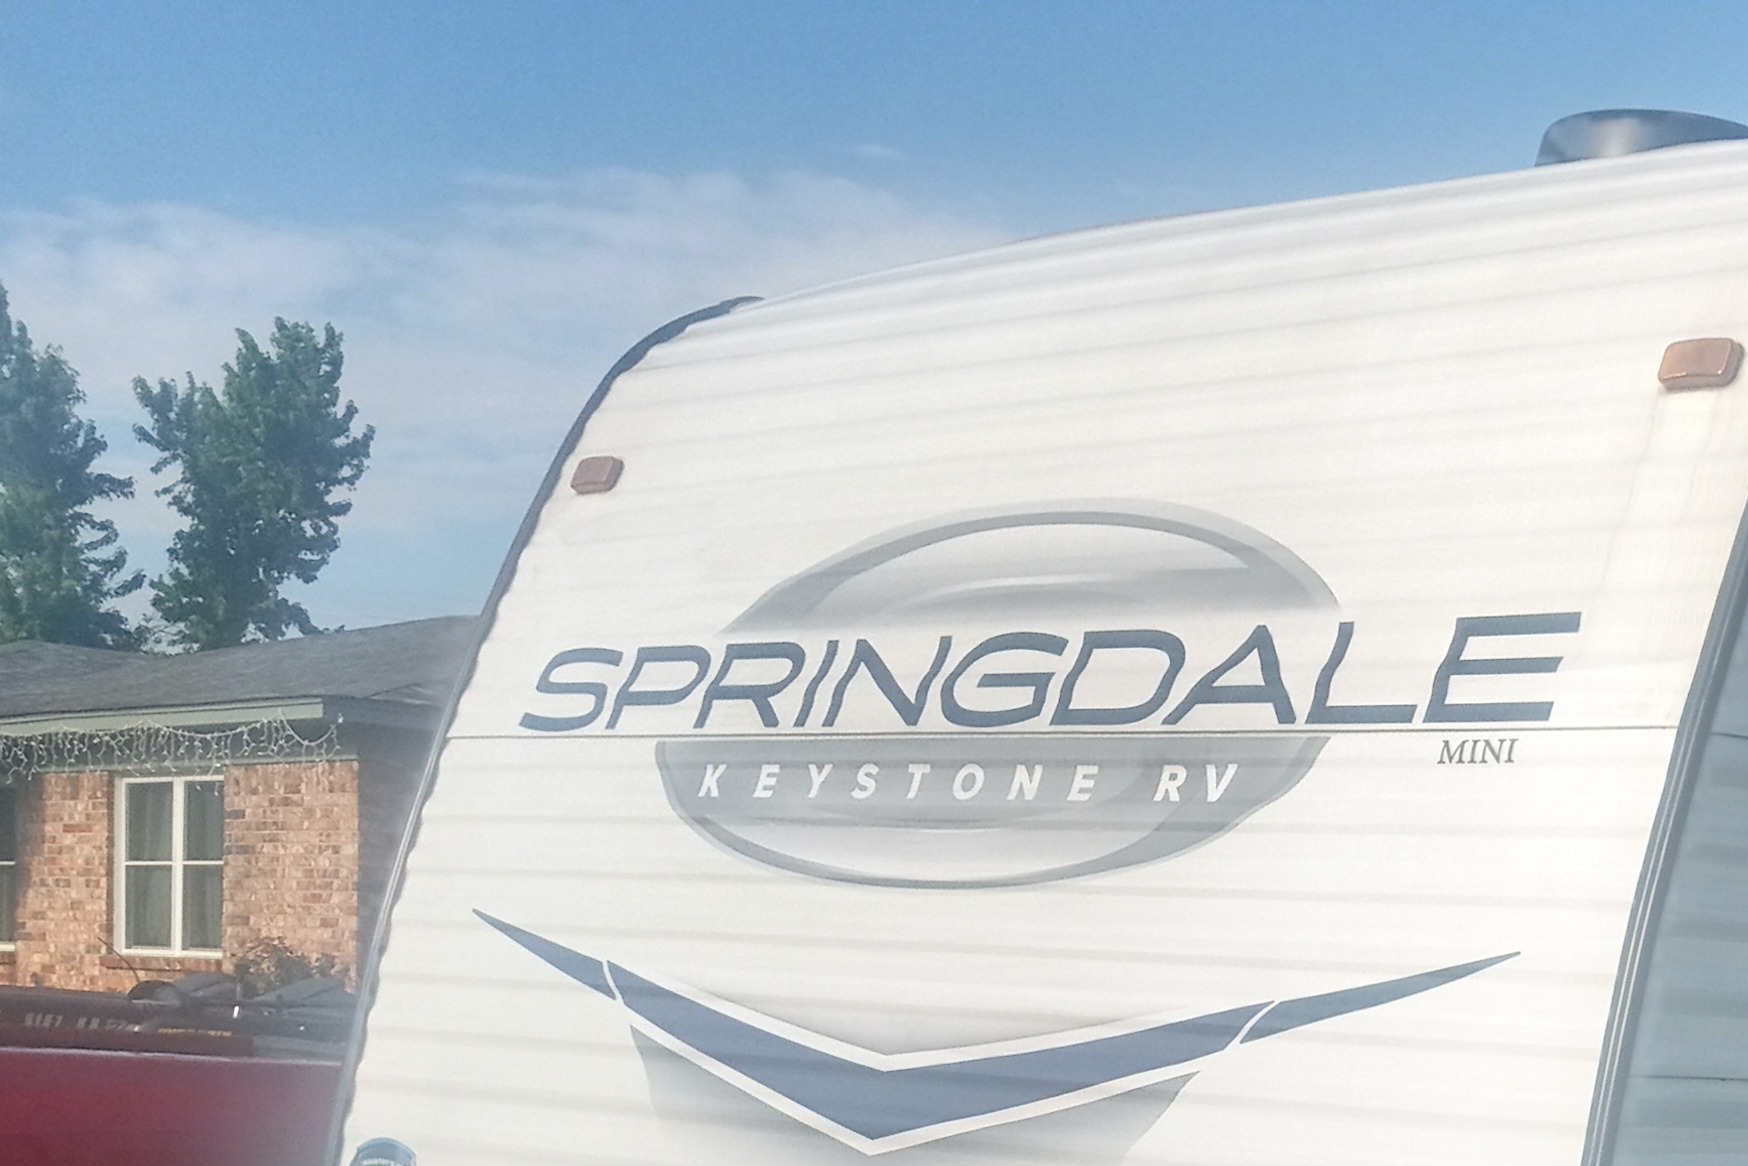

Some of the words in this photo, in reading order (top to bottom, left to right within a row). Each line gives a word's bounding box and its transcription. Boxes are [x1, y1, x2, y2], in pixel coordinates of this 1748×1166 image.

[519, 611, 1582, 732] SPRINGDALE
[1437, 738, 1519, 764] MINI
[698, 762, 1099, 801] KEYSTONE
[1153, 763, 1237, 802] RV
